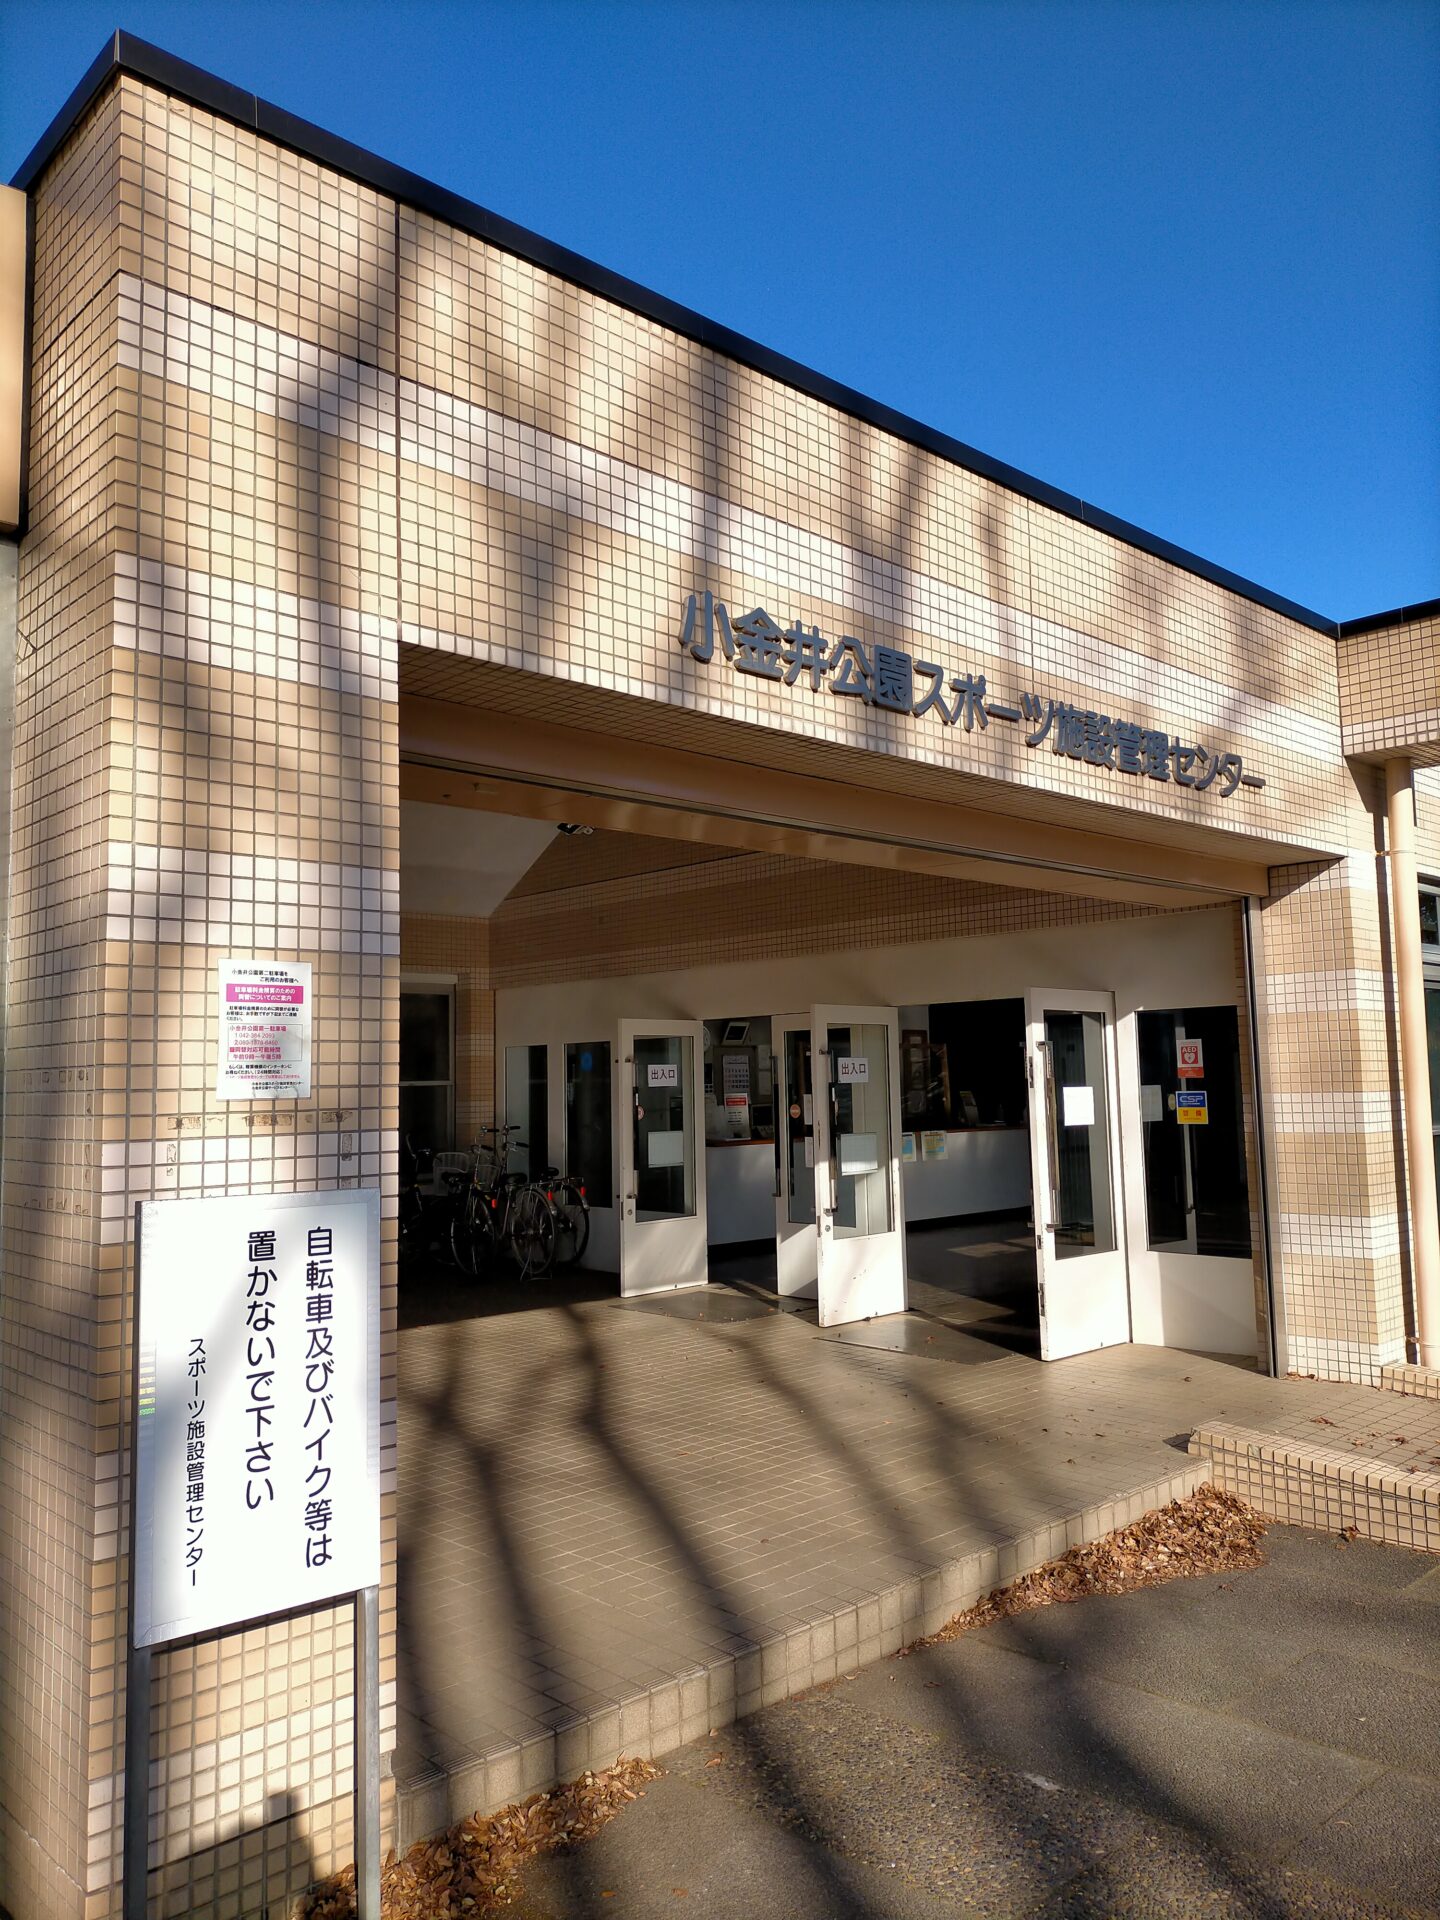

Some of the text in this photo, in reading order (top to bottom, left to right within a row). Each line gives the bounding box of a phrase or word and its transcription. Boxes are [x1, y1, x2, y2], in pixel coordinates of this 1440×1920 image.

[678, 589, 1266, 797] 小金井公園スポーツ施設管理センター
[650, 1068, 675, 1081] 出入口
[841, 1063, 867, 1075] 出入口
[1179, 1095, 1204, 1103] CSP
[185, 1337, 207, 1587] スポーツ施設管理センター
[244, 1230, 278, 1511] 置かないで下さい
[303, 1225, 335, 1568] 自転車及びバイク等は
